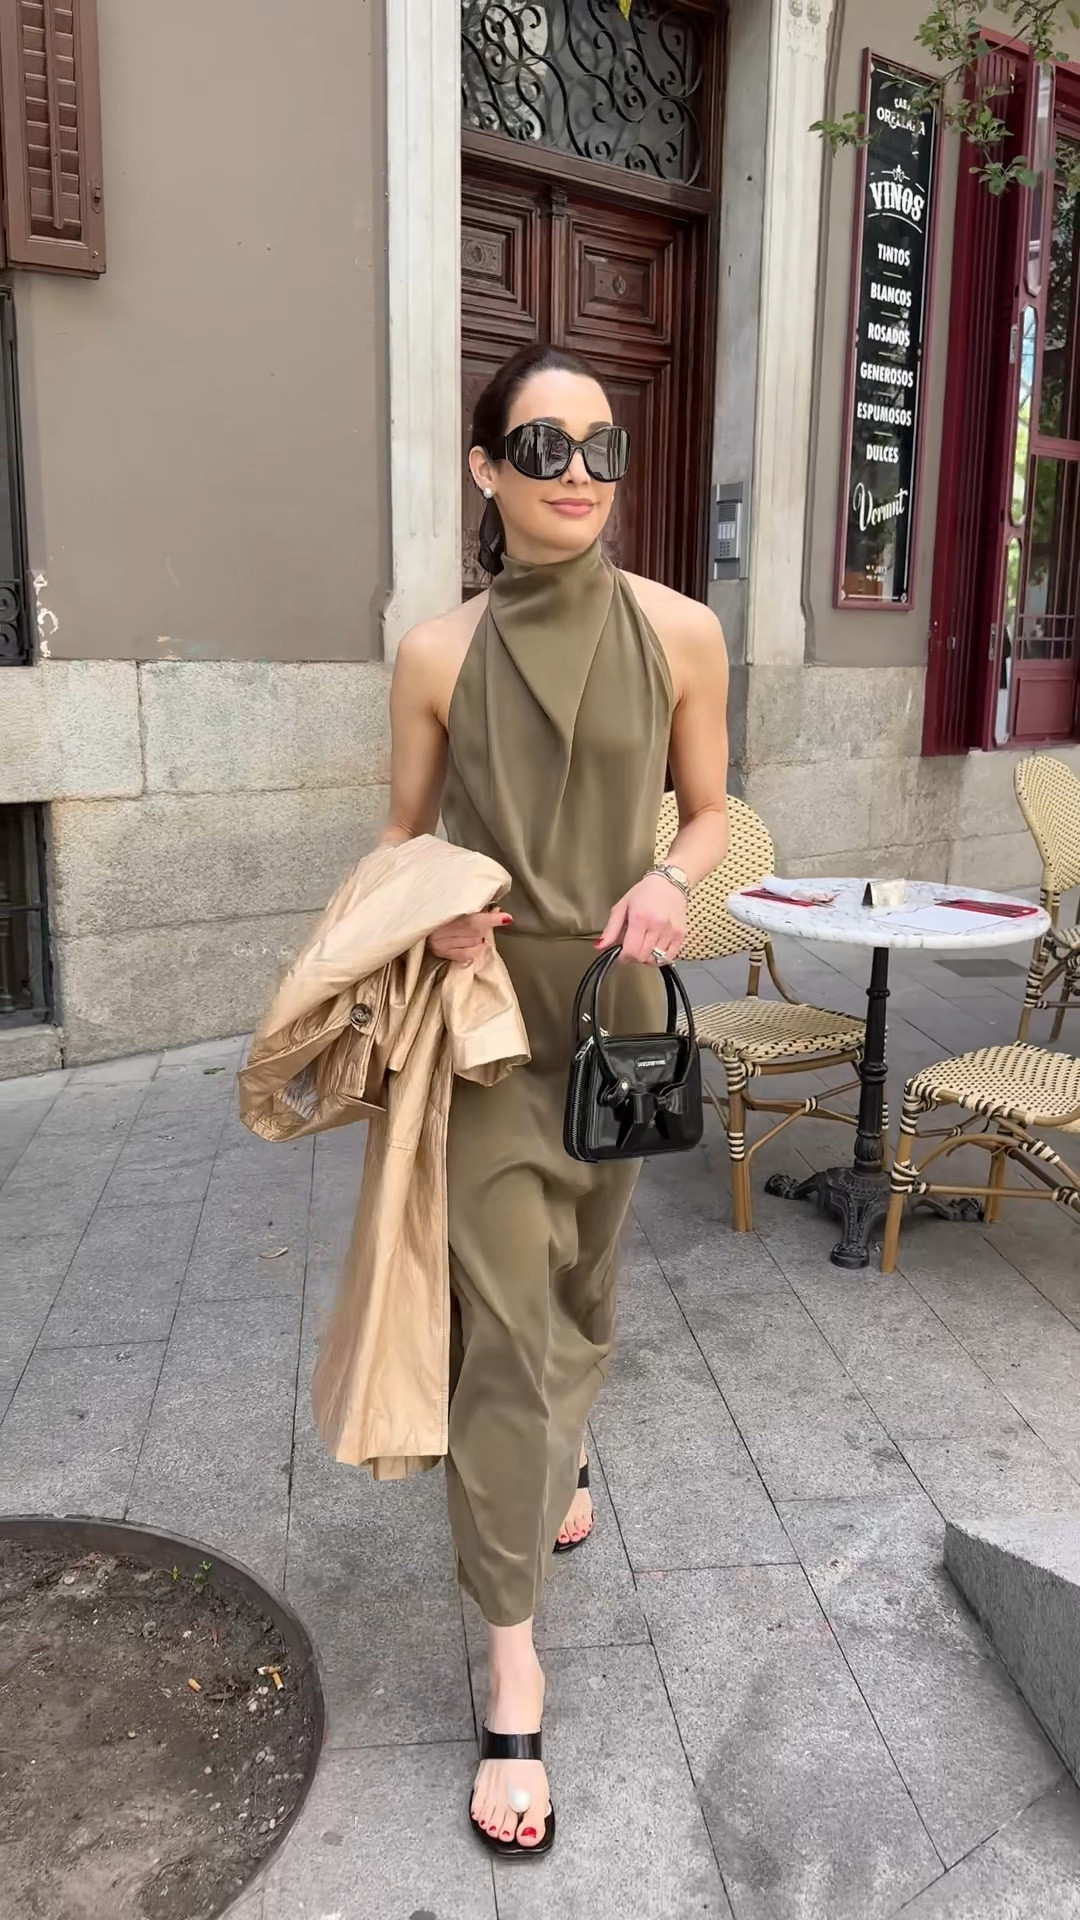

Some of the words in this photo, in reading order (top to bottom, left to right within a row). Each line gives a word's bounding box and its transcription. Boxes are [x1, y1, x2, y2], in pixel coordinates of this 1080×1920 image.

[869, 181, 925, 221] VINOS
[878, 243, 911, 267] TINTOS
[870, 282, 912, 307] BLANCOS
[867, 322, 910, 347] ROSADOS
[860, 361, 914, 388] GENEROSOS
[857, 401, 912, 427] ESPUMOSOS
[866, 443, 899, 464] DULCES
[852, 482, 908, 532] Vermut
